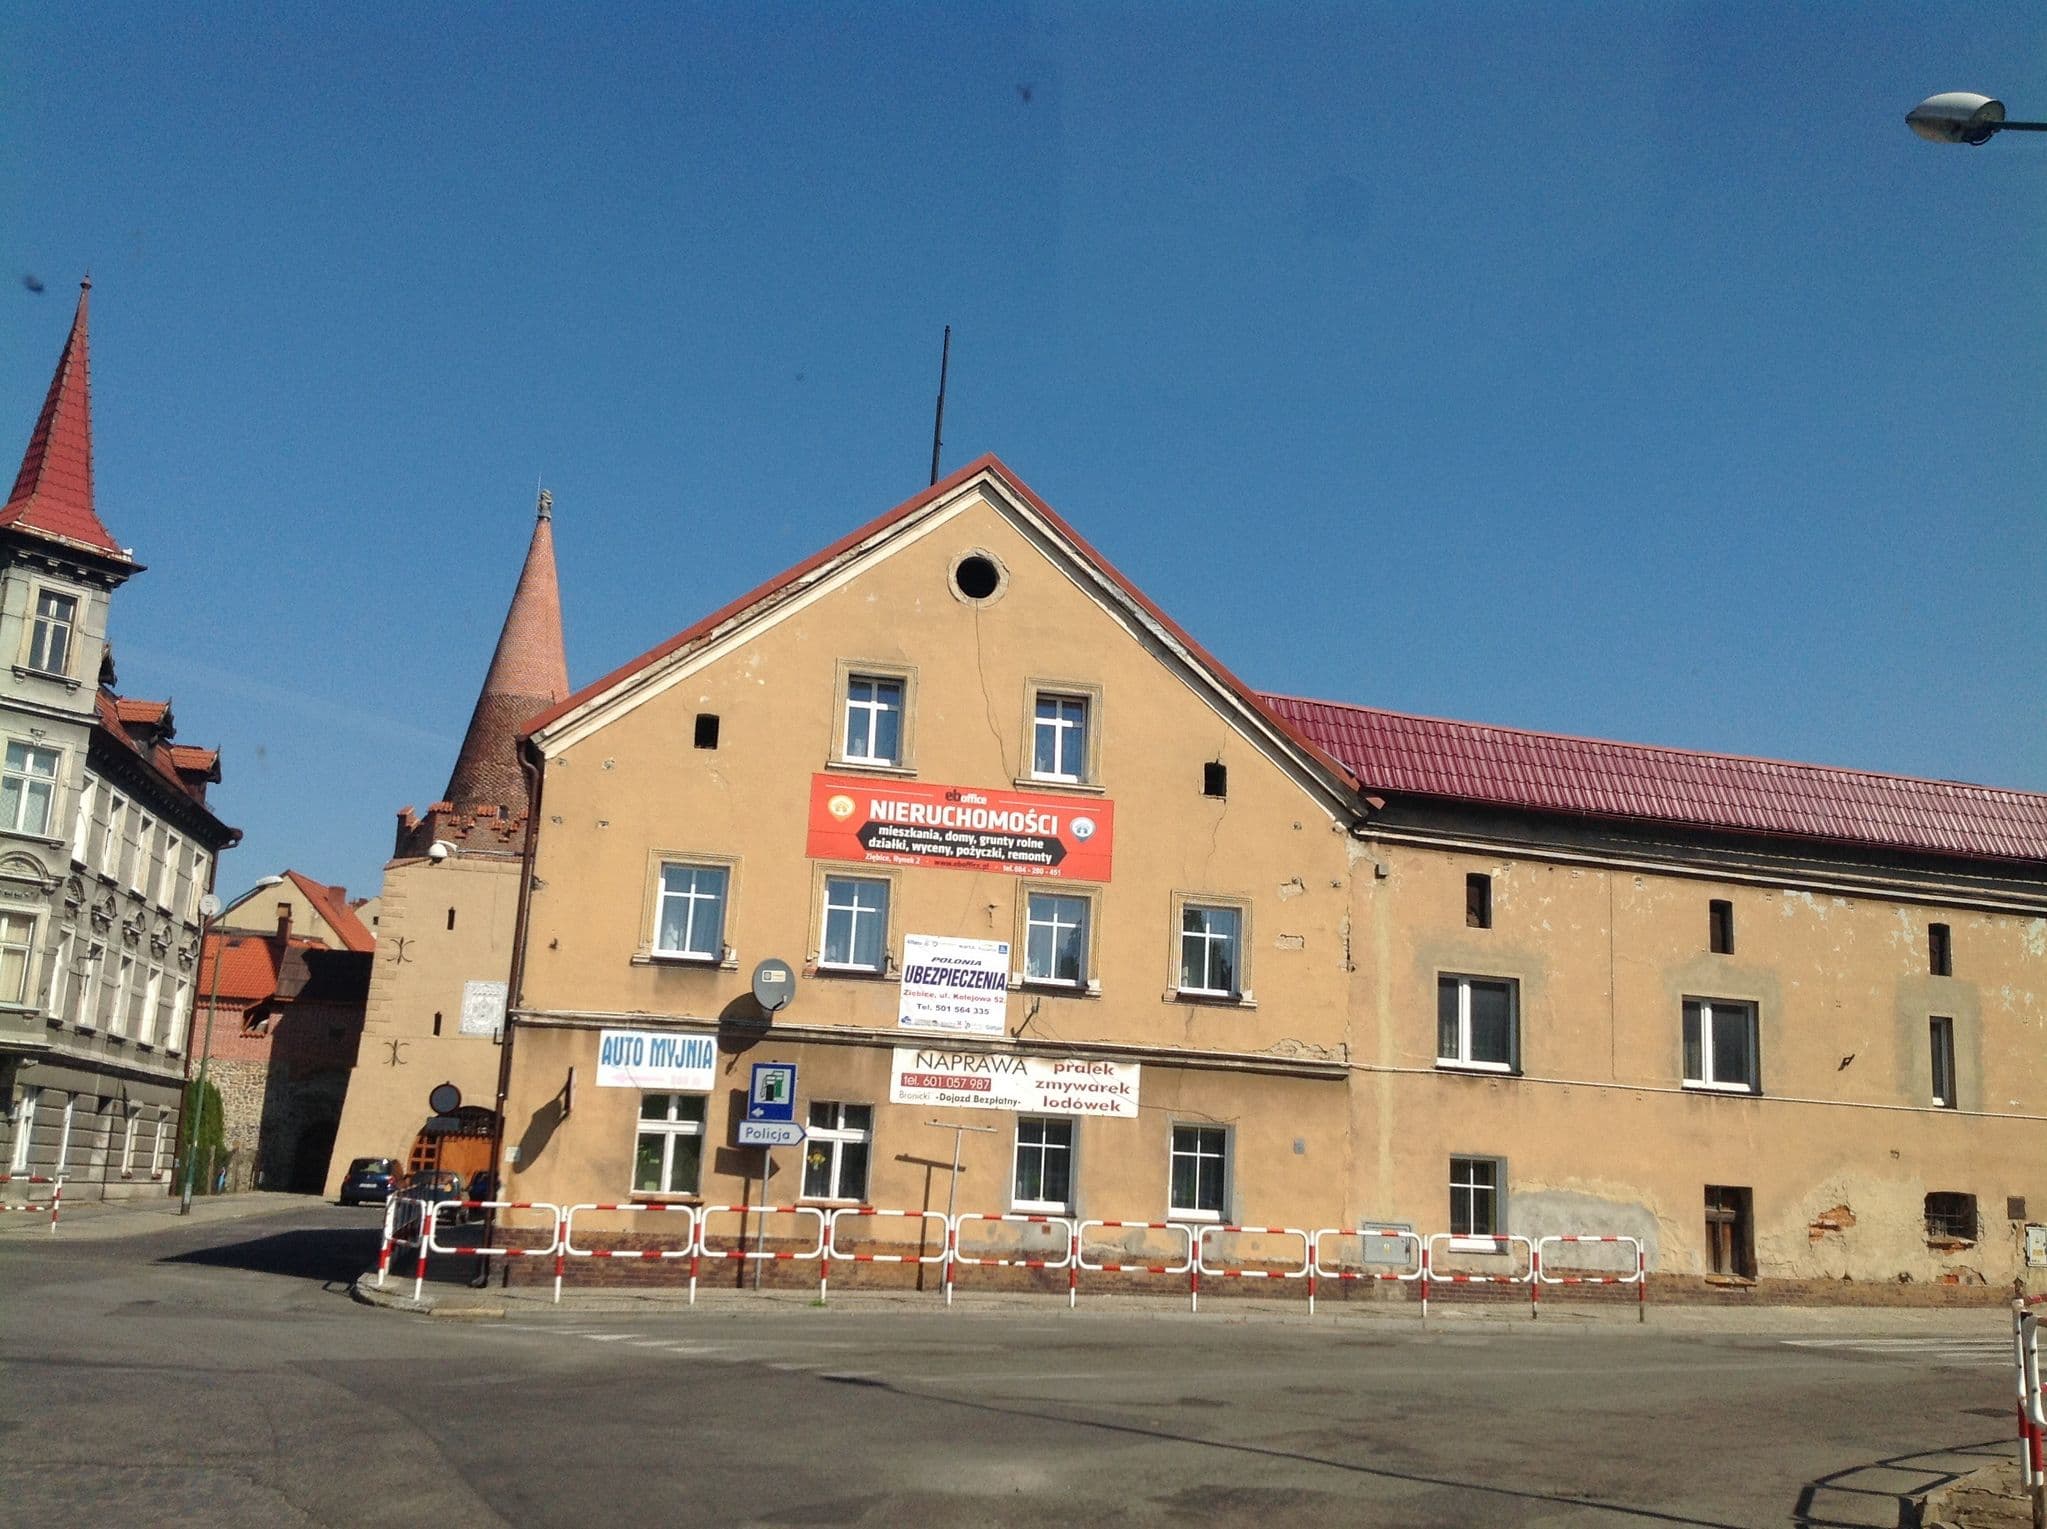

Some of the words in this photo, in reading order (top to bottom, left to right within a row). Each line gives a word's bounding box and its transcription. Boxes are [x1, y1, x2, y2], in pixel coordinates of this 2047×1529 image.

[869, 799, 1058, 835] NIERUCHOMOŚCI
[878, 825, 943, 842] mieszkania,
[945, 830, 977, 845] domy,
[980, 835, 1014, 849] grunty
[1016, 837, 1044, 849] rolne
[868, 837, 909, 852] działki,
[911, 842, 954, 857] wyceny,
[956, 846, 1005, 860] pożyczki,
[1007, 850, 1053, 865] remonty
[931, 956, 982, 966] POLONIA
[904, 964, 1007, 991] UBEZPIECZENIA
[917, 1003, 932, 1011] Tel.
[935, 1004, 950, 1012] 501
[601, 1036, 644, 1067] AUTO
[649, 1037, 713, 1069] MYJNIA
[915, 1051, 1028, 1076] NAPRAWA
[1053, 1061, 1115, 1076] pralek
[903, 1075, 919, 1086] tel.
[923, 1076, 942, 1087] 601
[946, 1077, 966, 1089] 057
[969, 1078, 990, 1090] 987
[1035, 1078, 1131, 1096] zmywarek
[1043, 1095, 1121, 1112] lodówek
[745, 1126, 791, 1142] Policja
